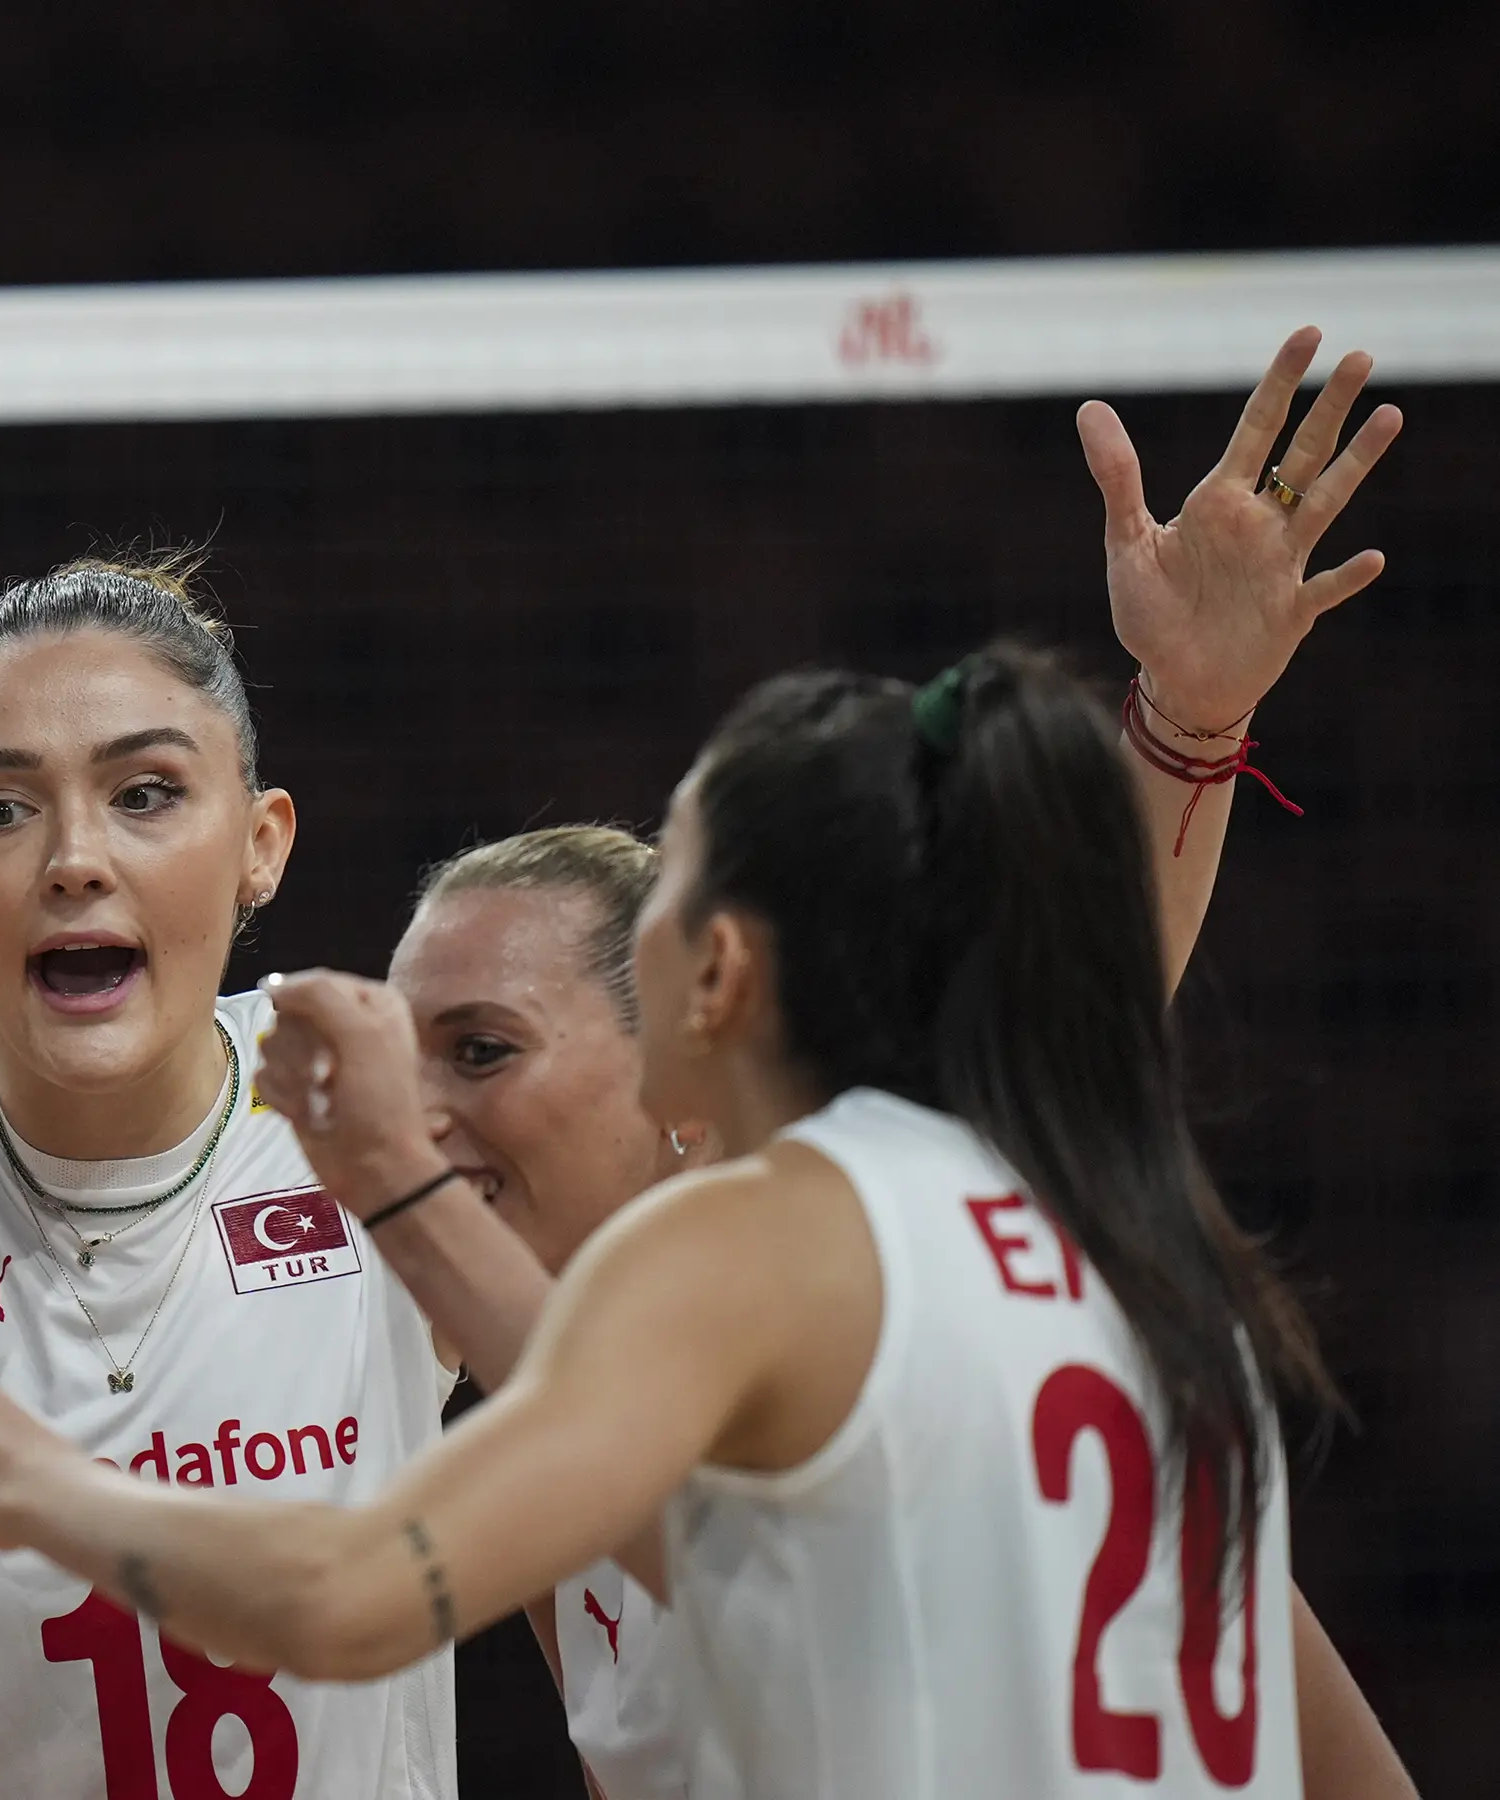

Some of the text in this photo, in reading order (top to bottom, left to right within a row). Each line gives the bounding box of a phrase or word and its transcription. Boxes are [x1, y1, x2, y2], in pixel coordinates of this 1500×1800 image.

[262, 1256, 330, 1281] TUR
[92, 1415, 359, 1489] dafone
[1031, 1362, 1260, 1790] 20
[41, 1583, 299, 1800] 18
